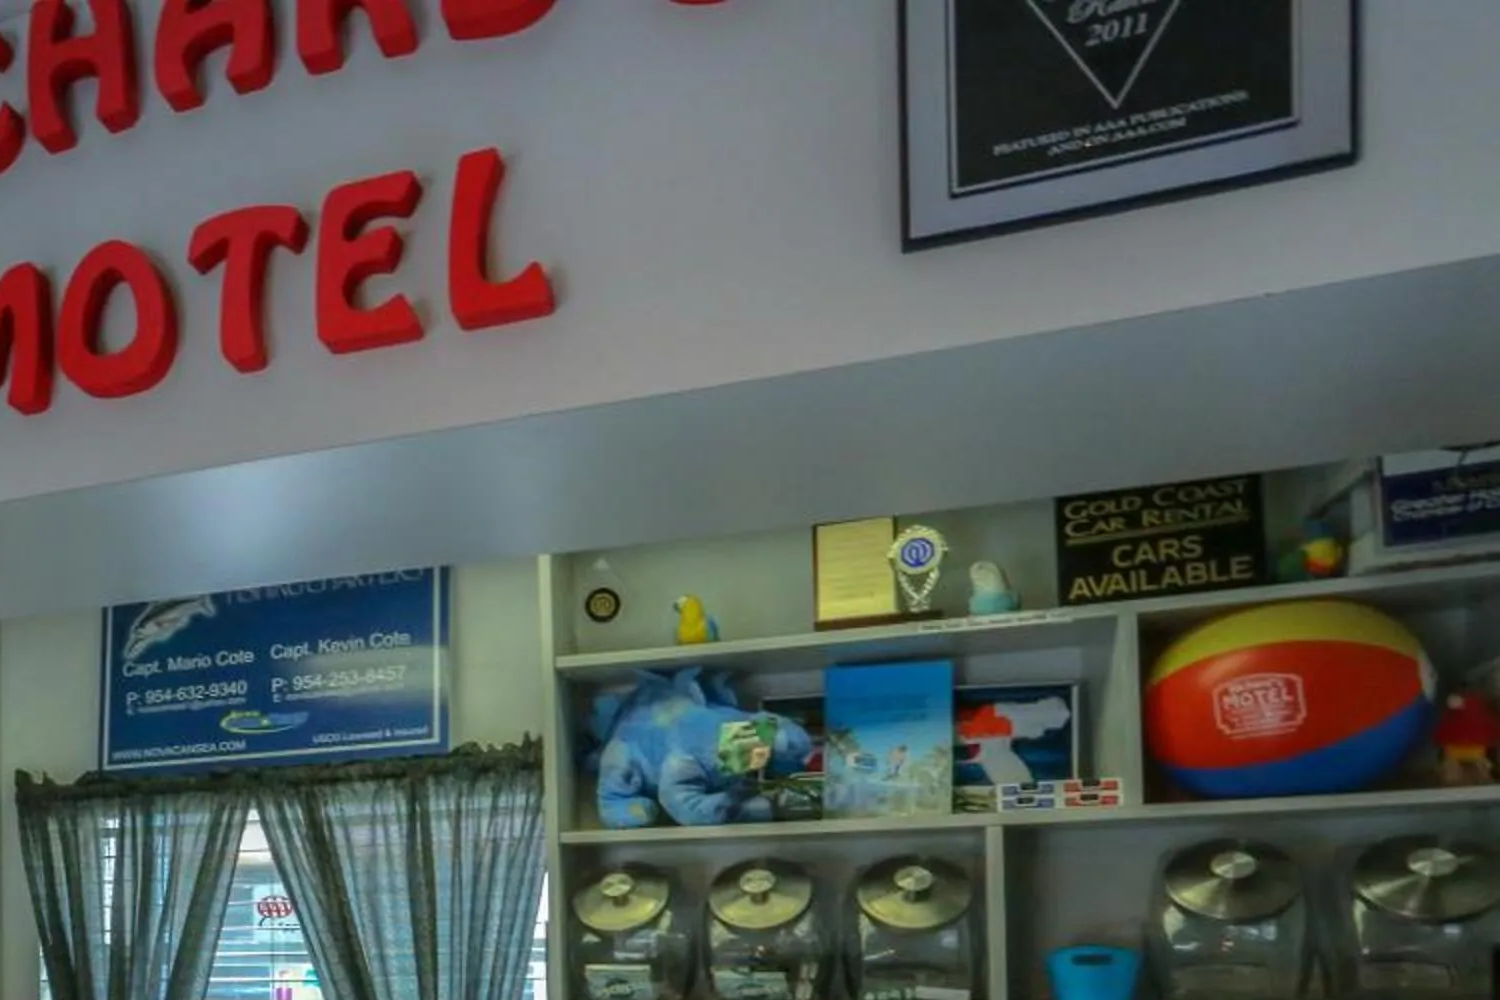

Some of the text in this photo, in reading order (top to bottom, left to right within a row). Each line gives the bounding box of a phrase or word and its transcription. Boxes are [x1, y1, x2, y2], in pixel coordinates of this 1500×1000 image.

[1084, 12, 1149, 47] 2011
[1064, 478, 1248, 521] GOLD COAST
[1064, 499, 1250, 538] CAR RENTAL
[1111, 534, 1205, 569] CARS
[1068, 554, 1255, 601] AVAILABLE
[270, 630, 412, 661] Capt. Kevin Cote
[122, 659, 161, 679] Capt.
[215, 650, 255, 667] Cote
[145, 681, 248, 704] 954-632-9340
[270, 677, 288, 693] P:
